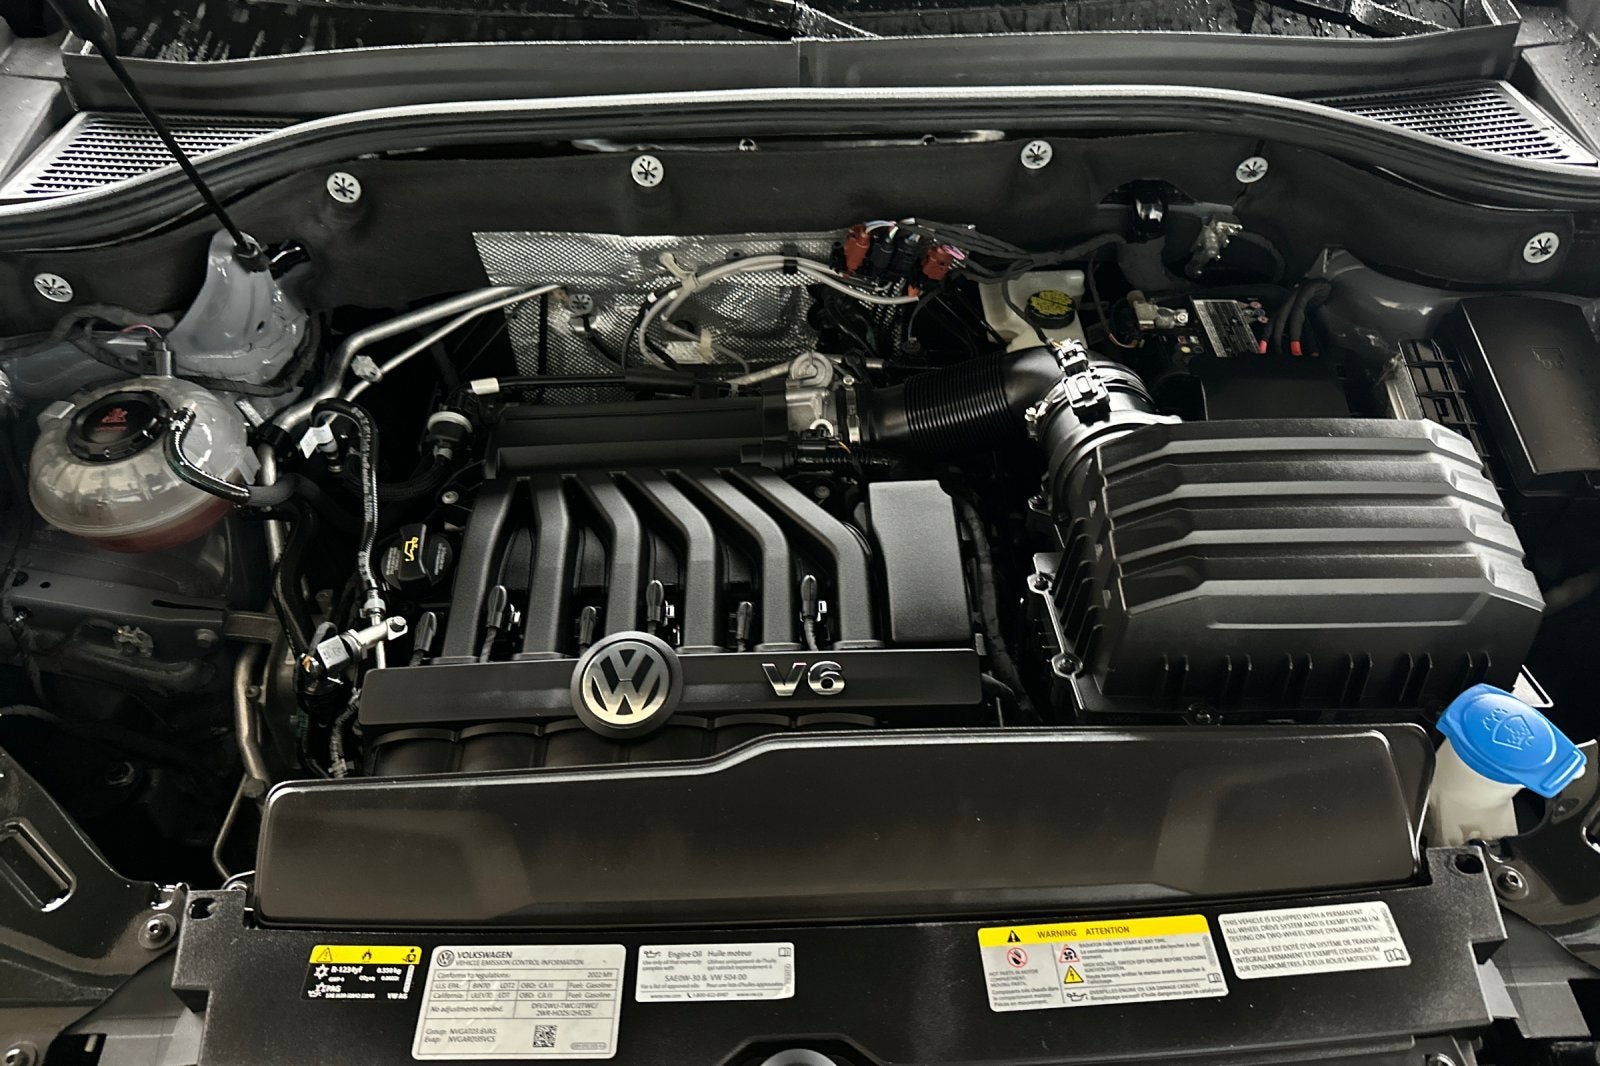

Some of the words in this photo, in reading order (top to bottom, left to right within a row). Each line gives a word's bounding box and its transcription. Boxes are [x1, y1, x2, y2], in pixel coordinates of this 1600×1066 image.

[762, 660, 846, 696] V6
[1271, 914, 1301, 922] EQUIPPED
[1326, 908, 1362, 916] PERMANENT
[1038, 929, 1077, 938] WARNING
[1086, 926, 1130, 935] ATTENTION
